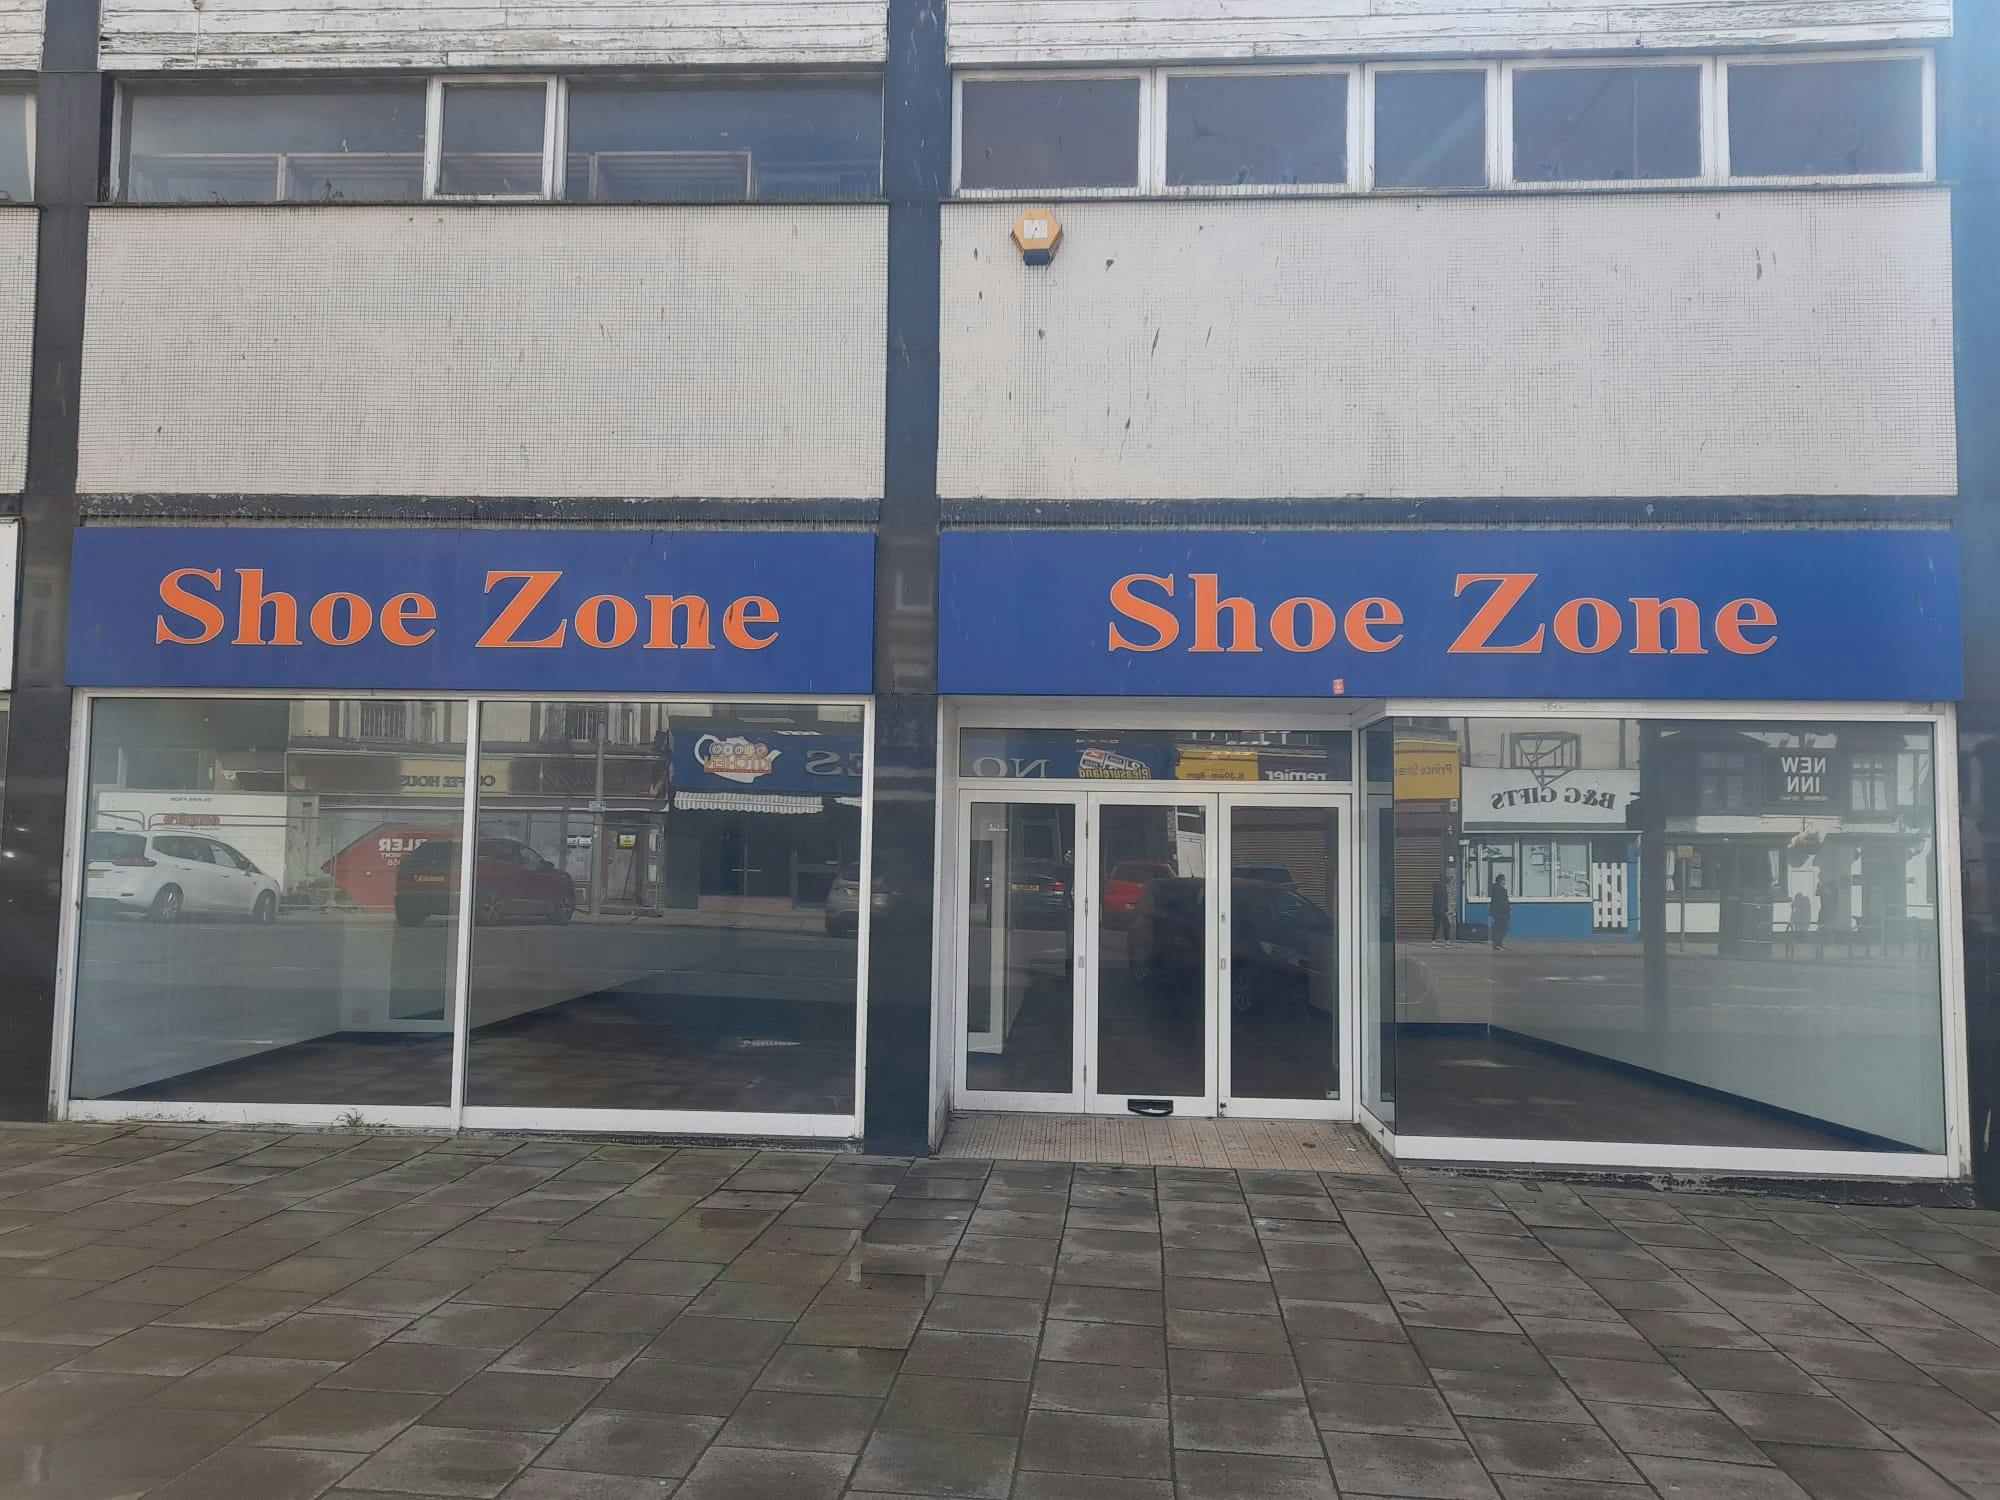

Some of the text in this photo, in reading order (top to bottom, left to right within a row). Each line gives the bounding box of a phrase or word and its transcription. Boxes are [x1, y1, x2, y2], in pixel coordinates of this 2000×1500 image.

[157, 569, 779, 649] Shoe Zone
[1110, 575, 1776, 653] Shoe Zone
